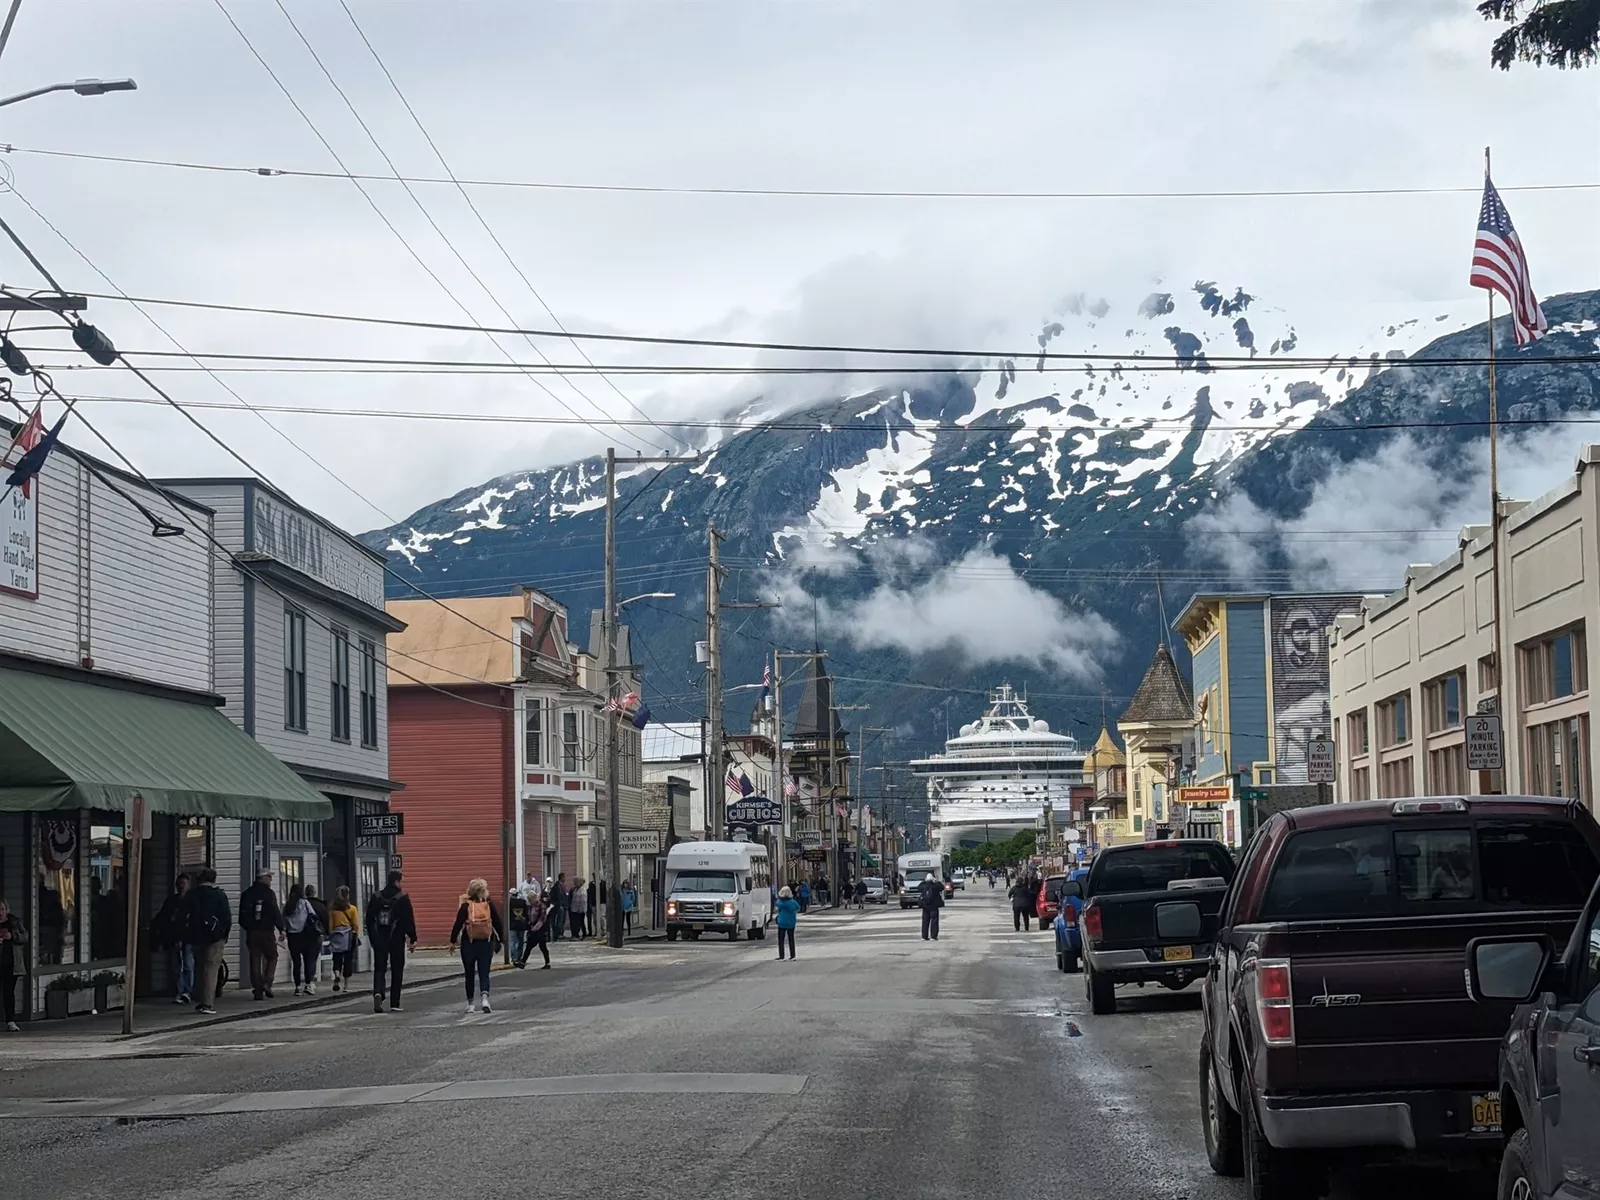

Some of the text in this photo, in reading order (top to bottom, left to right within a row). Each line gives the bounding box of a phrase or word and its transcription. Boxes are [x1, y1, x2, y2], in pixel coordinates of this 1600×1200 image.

[9, 526, 30, 552] Locally
[256, 496, 324, 579] SKAGWAY
[4, 546, 34, 572] Hand Dyed
[10, 569, 28, 588] Yarns
[1476, 722, 1488, 731] 20
[1471, 732, 1494, 741] MINUTE
[1470, 743, 1497, 751] PARKING
[1184, 790, 1208, 799] Jewelry
[728, 808, 781, 820] CURIOS
[362, 816, 397, 826] BITES
